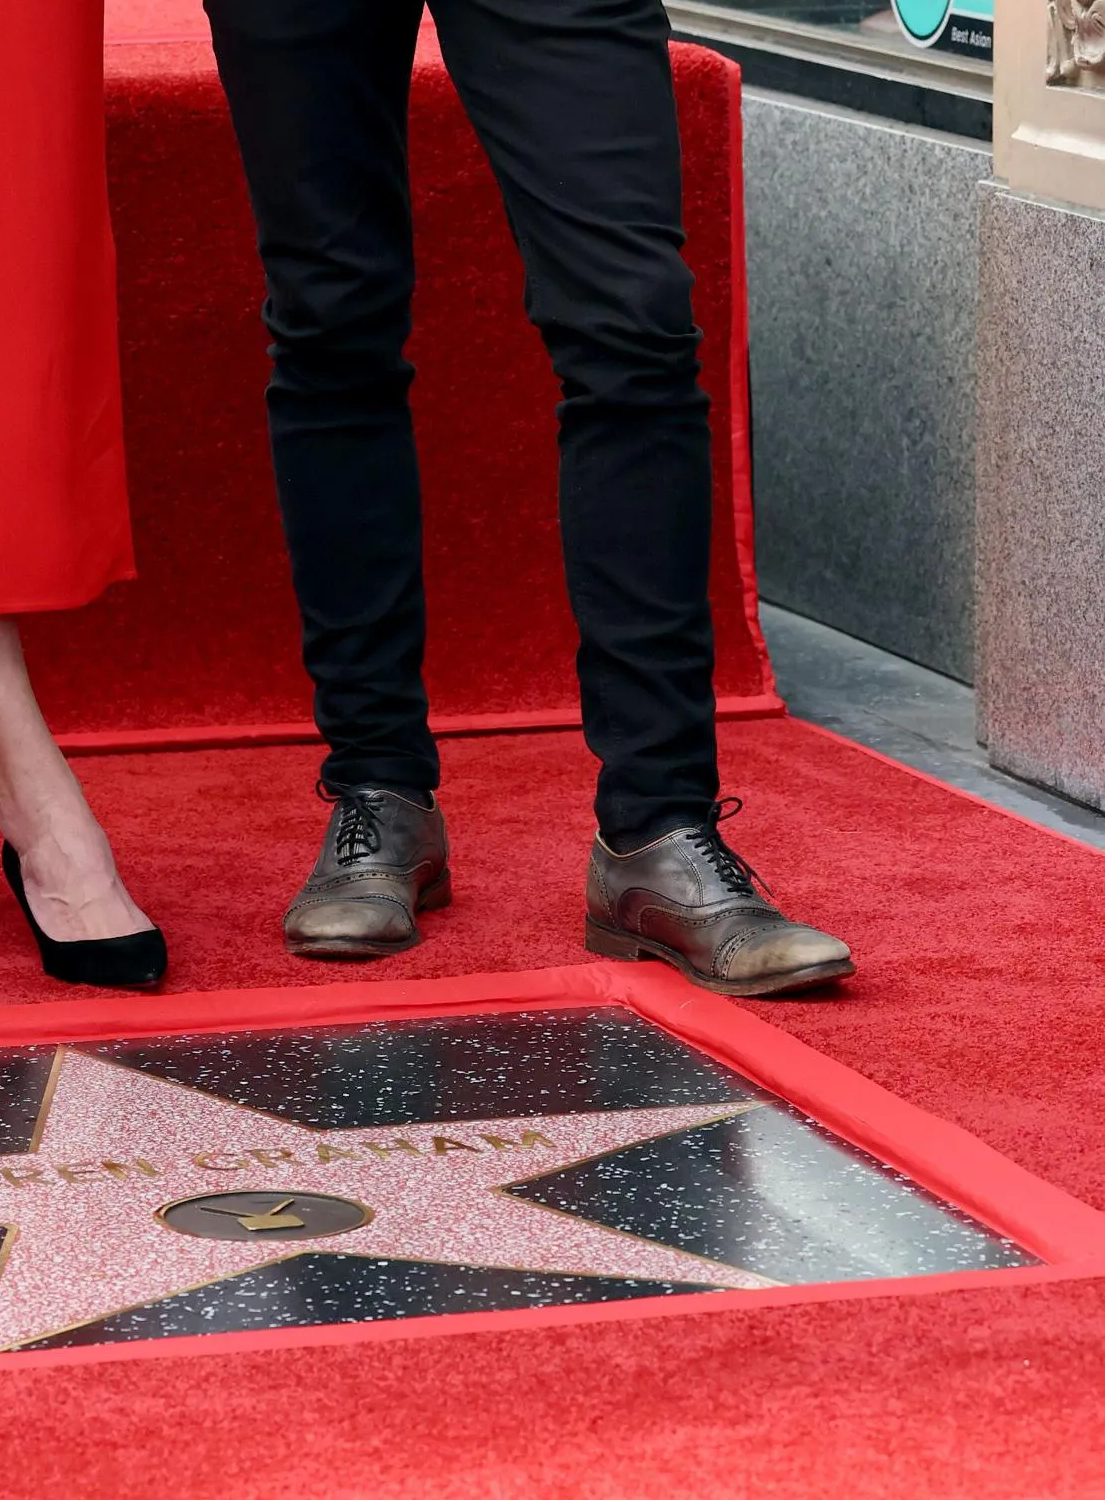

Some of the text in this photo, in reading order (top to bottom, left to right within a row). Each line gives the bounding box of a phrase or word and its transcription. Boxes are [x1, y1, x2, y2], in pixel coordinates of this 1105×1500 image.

[951, 25, 992, 49] Best Asian
[194, 1130, 556, 1171] GRAHAM
